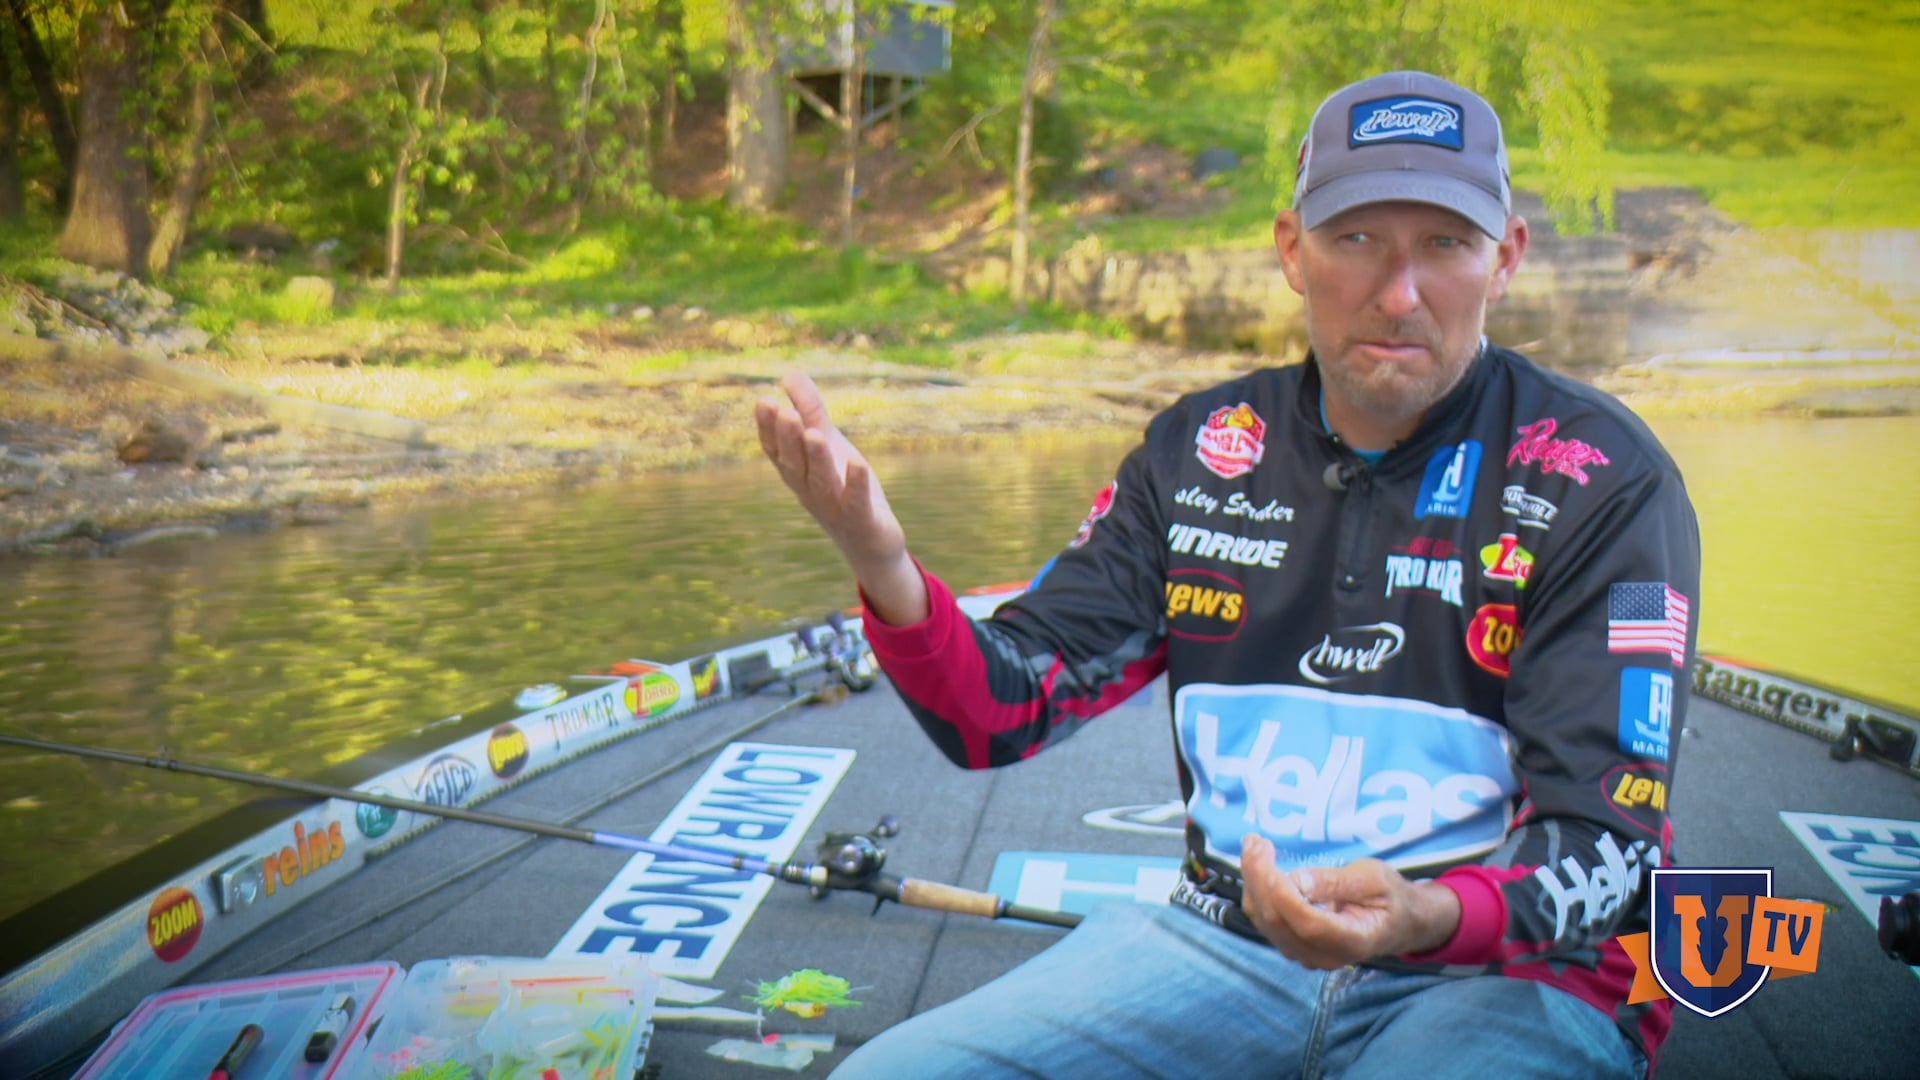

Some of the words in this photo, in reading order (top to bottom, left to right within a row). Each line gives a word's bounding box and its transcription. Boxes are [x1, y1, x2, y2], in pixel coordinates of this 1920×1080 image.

[1168, 523, 1289, 569] VINRUDE
[1196, 713, 1502, 847] Hellas
[263, 821, 345, 897] reins
[151, 897, 198, 947] ZOOM
